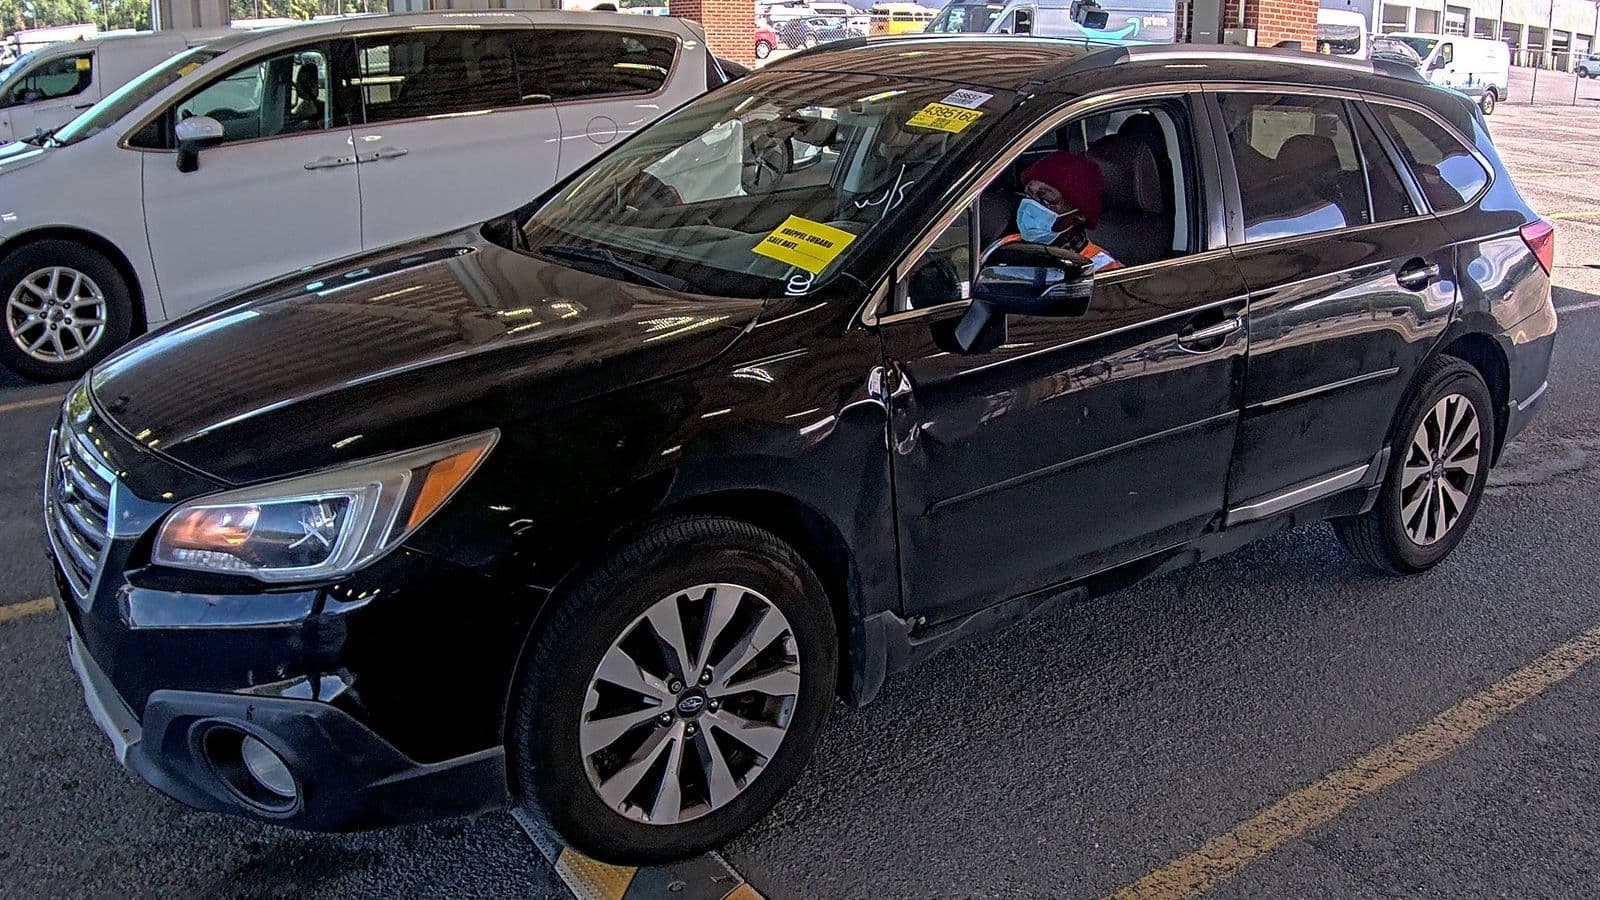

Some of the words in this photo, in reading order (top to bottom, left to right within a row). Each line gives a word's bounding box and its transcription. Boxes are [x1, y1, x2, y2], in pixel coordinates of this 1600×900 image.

[1143, 13, 1169, 28] prime
[766, 235, 782, 246] SALE
[780, 239, 799, 250] DATE
[804, 233, 835, 249] SUBARU
